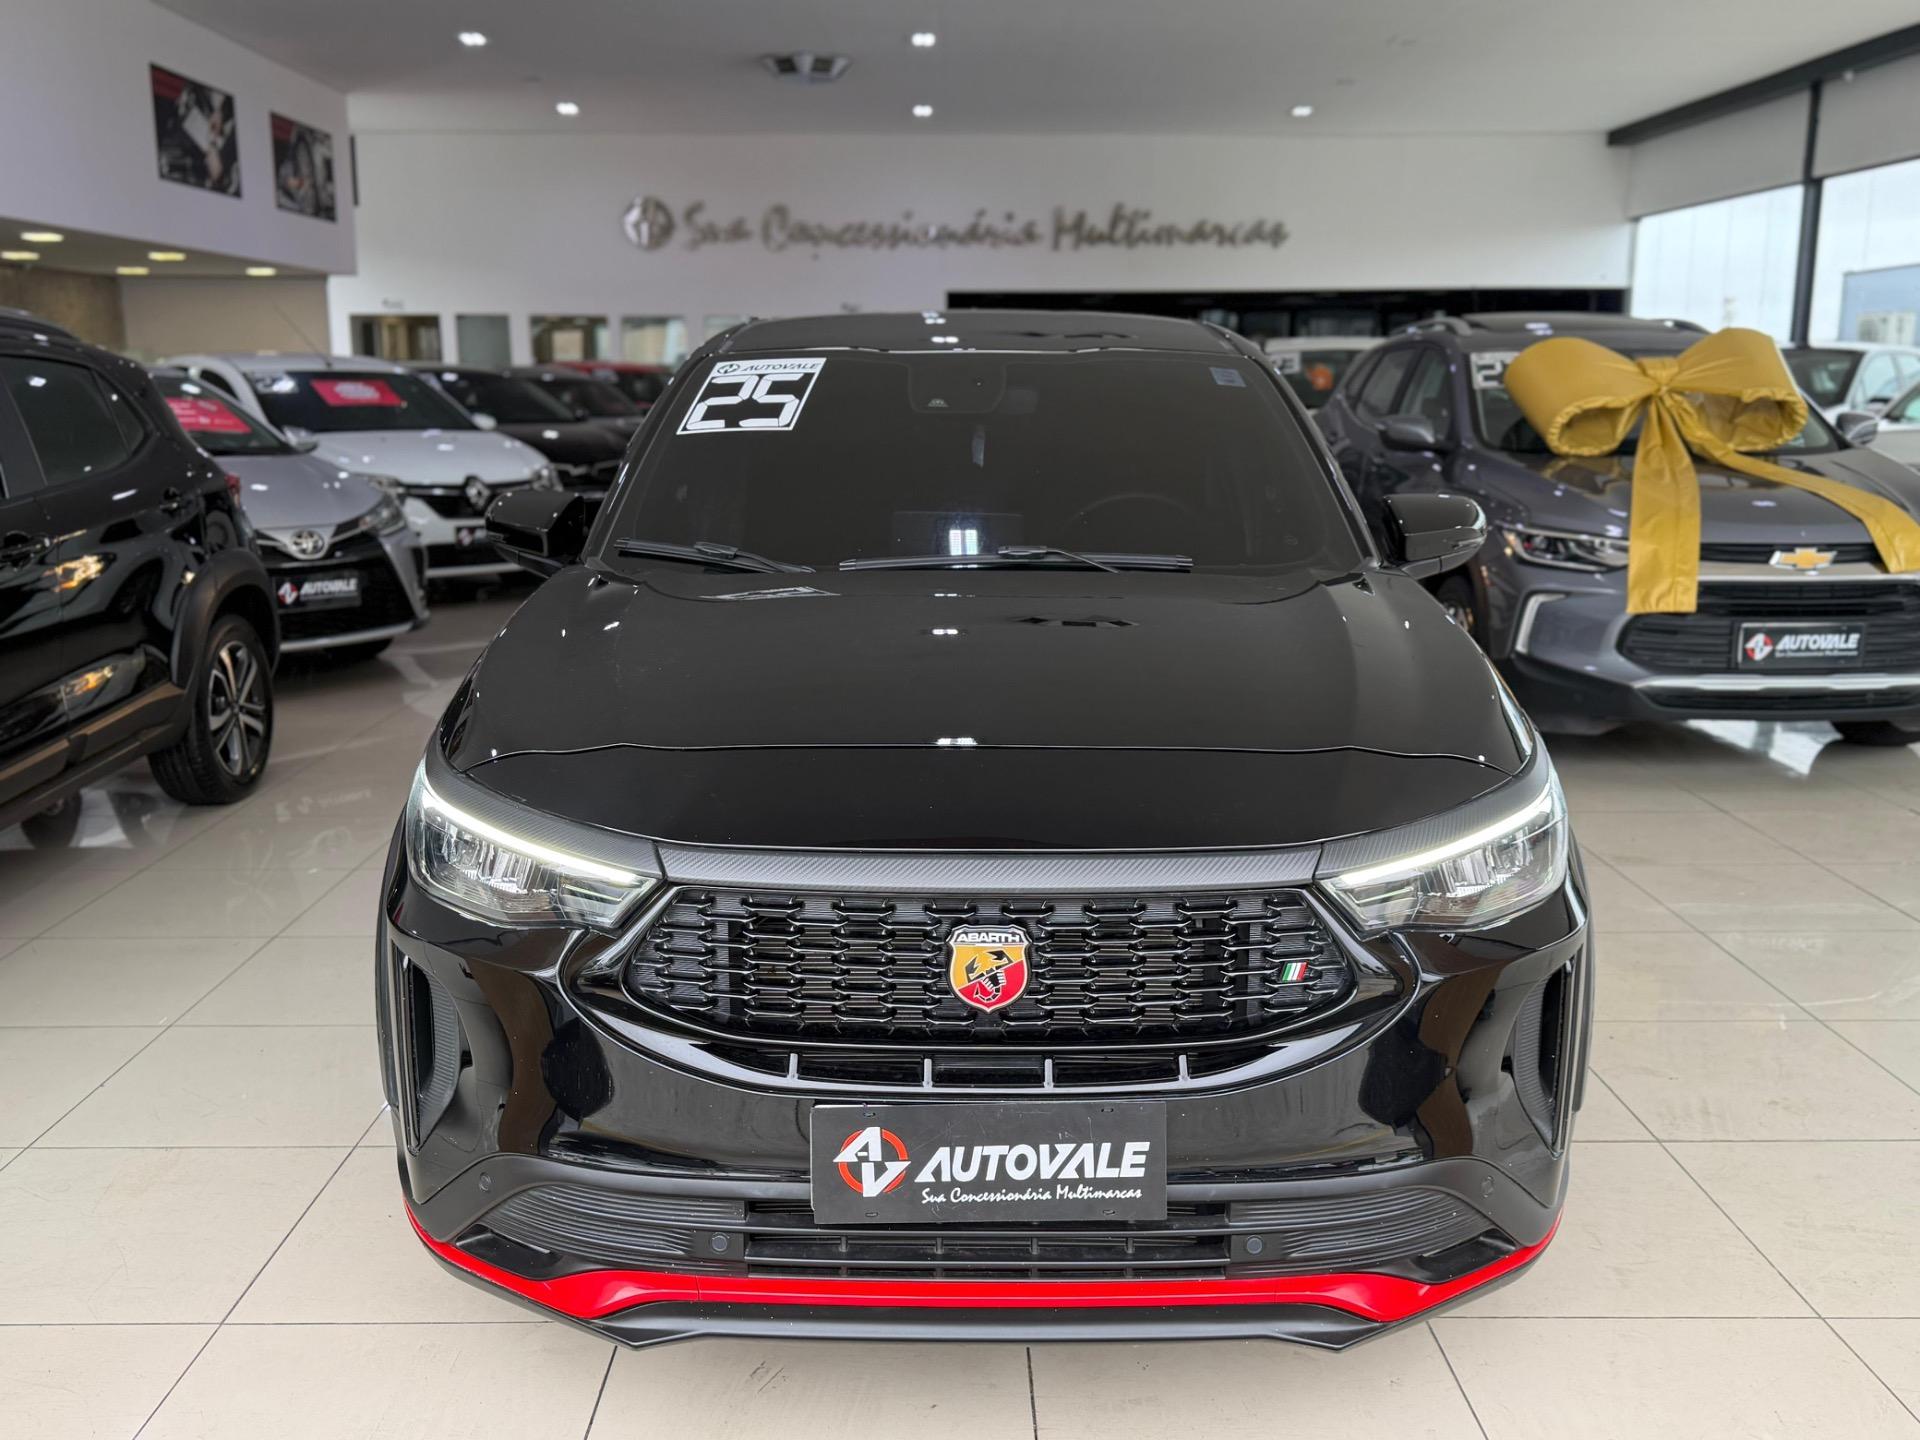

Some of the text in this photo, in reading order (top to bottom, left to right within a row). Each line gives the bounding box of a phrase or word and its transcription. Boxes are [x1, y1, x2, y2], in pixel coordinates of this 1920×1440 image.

[742, 363, 821, 372] AUTOVALE
[686, 373, 803, 430] 25
[1776, 633, 1861, 651] AUTOVALE
[957, 932, 1020, 943] ABARTH
[914, 1141, 1150, 1183] AUTOVALE
[921, 1184, 1143, 1205] Sua Concessionária Multimarcas
